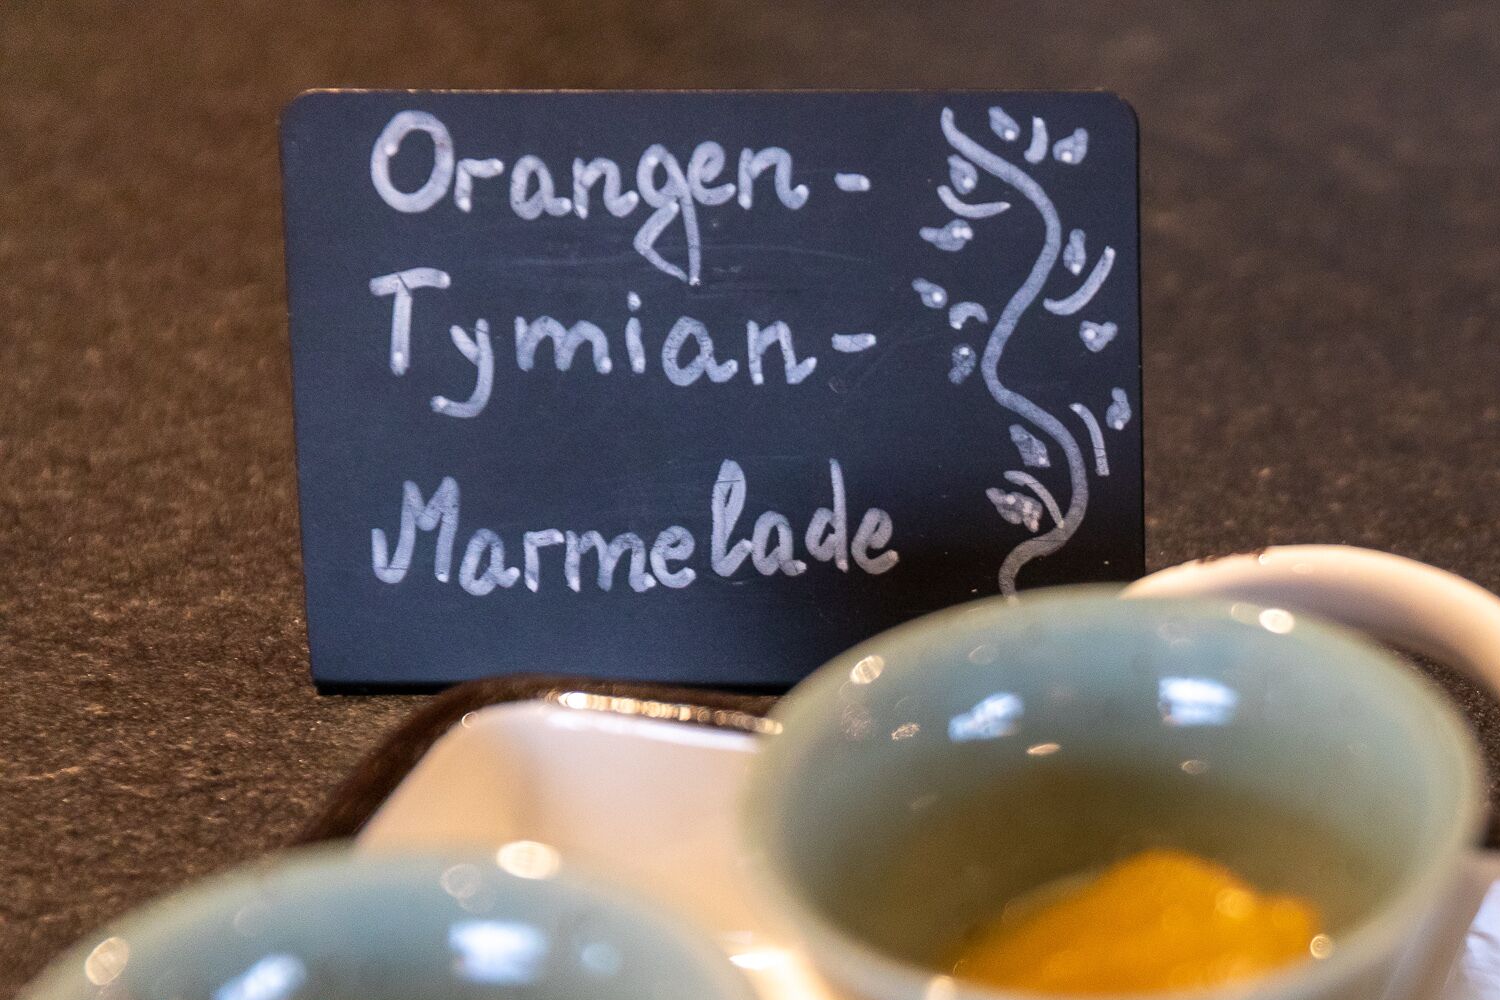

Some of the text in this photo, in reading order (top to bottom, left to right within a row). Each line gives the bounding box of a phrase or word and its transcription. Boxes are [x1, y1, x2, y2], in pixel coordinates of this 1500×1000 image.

[370, 110, 872, 286] Orangen-
[369, 267, 877, 418] Tymian-
[371, 459, 899, 597] Marmelade
